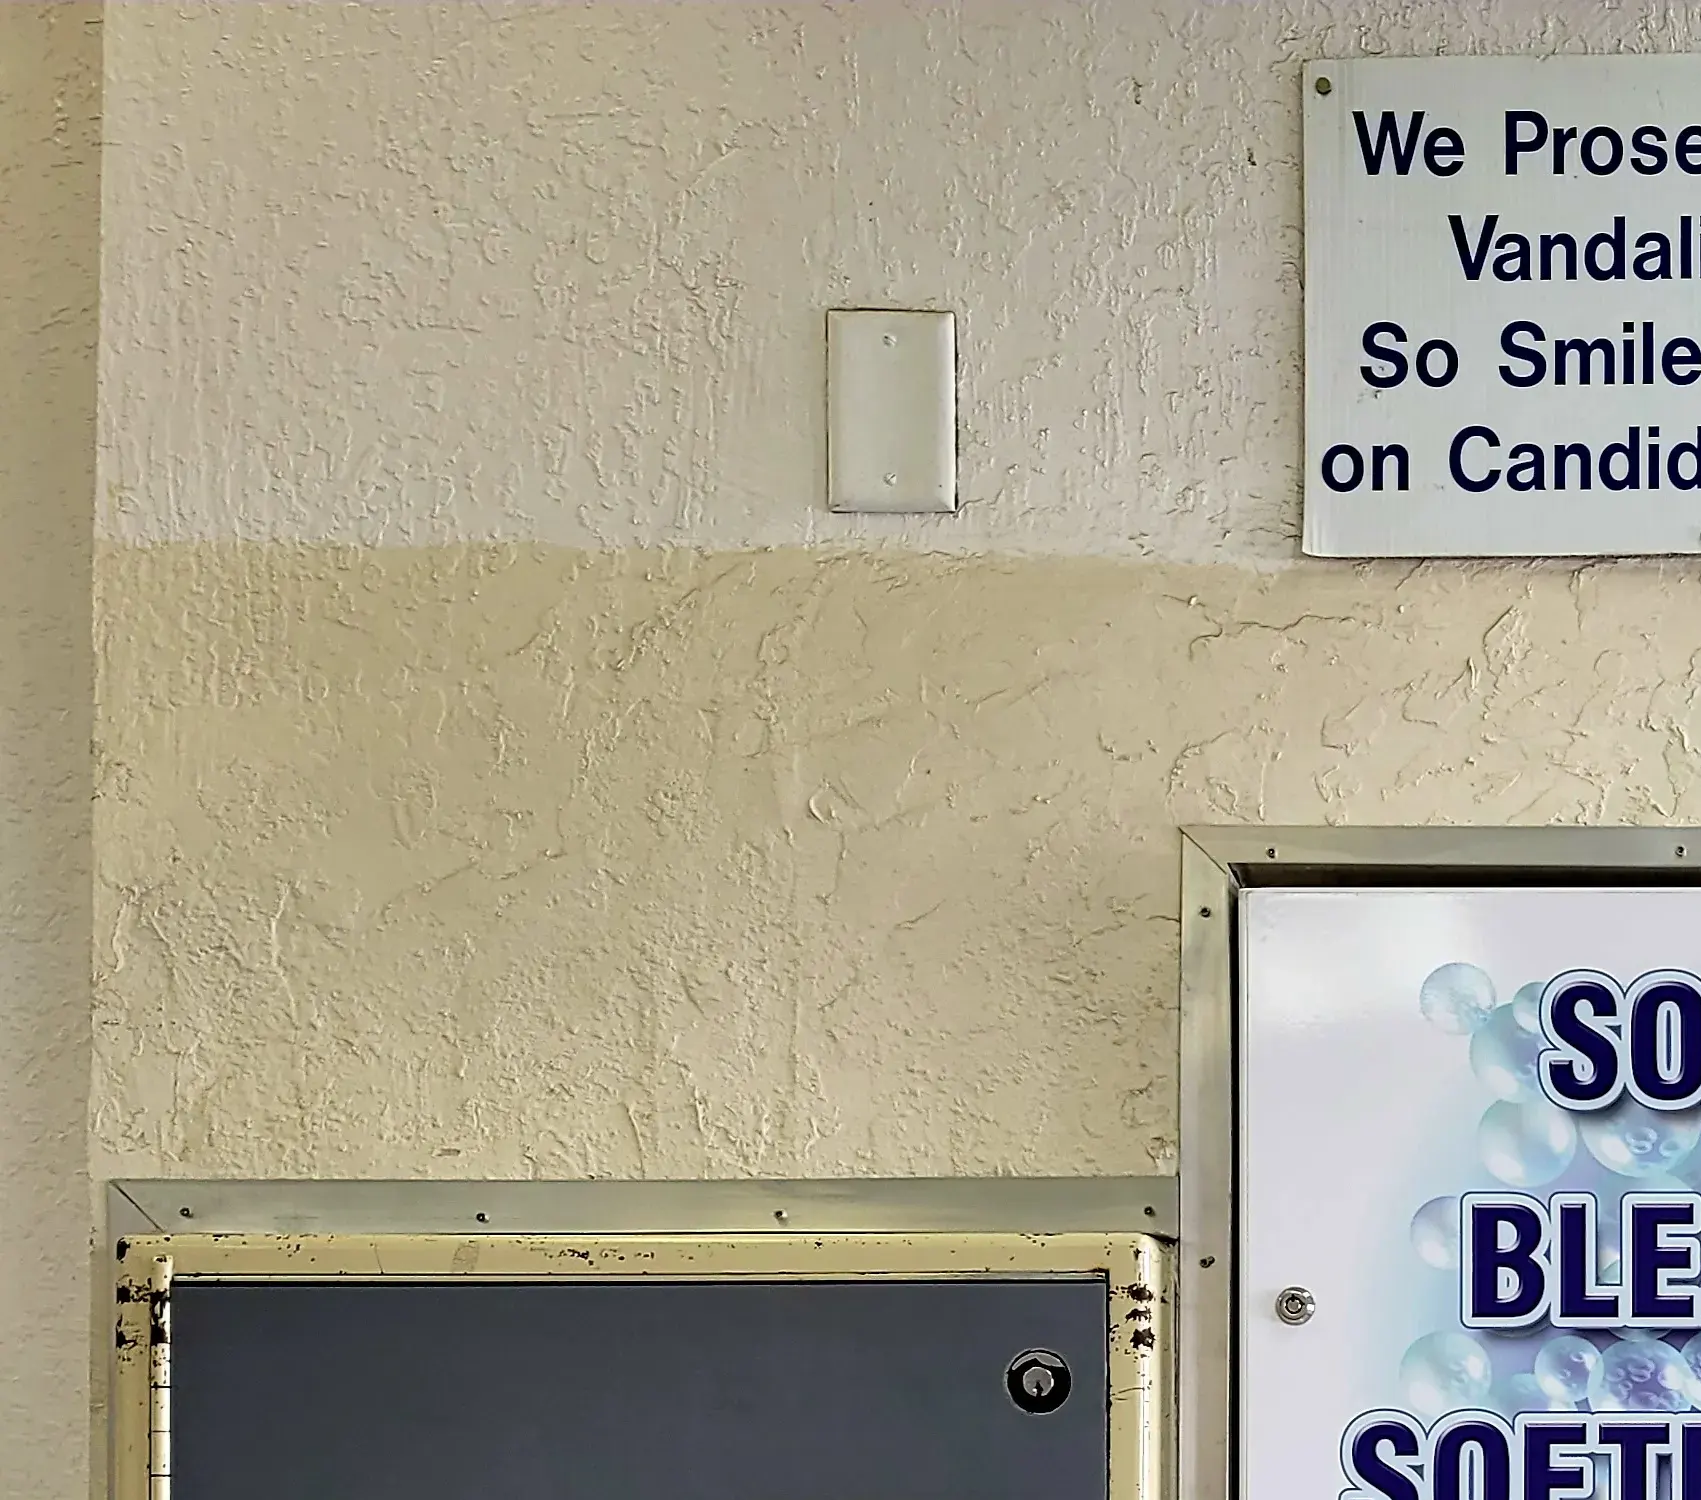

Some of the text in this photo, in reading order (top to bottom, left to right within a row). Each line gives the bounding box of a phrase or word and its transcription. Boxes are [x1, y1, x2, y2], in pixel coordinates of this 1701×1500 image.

[1352, 110, 1465, 176] We
[1360, 320, 1459, 388] So
[1321, 443, 1410, 492] on
